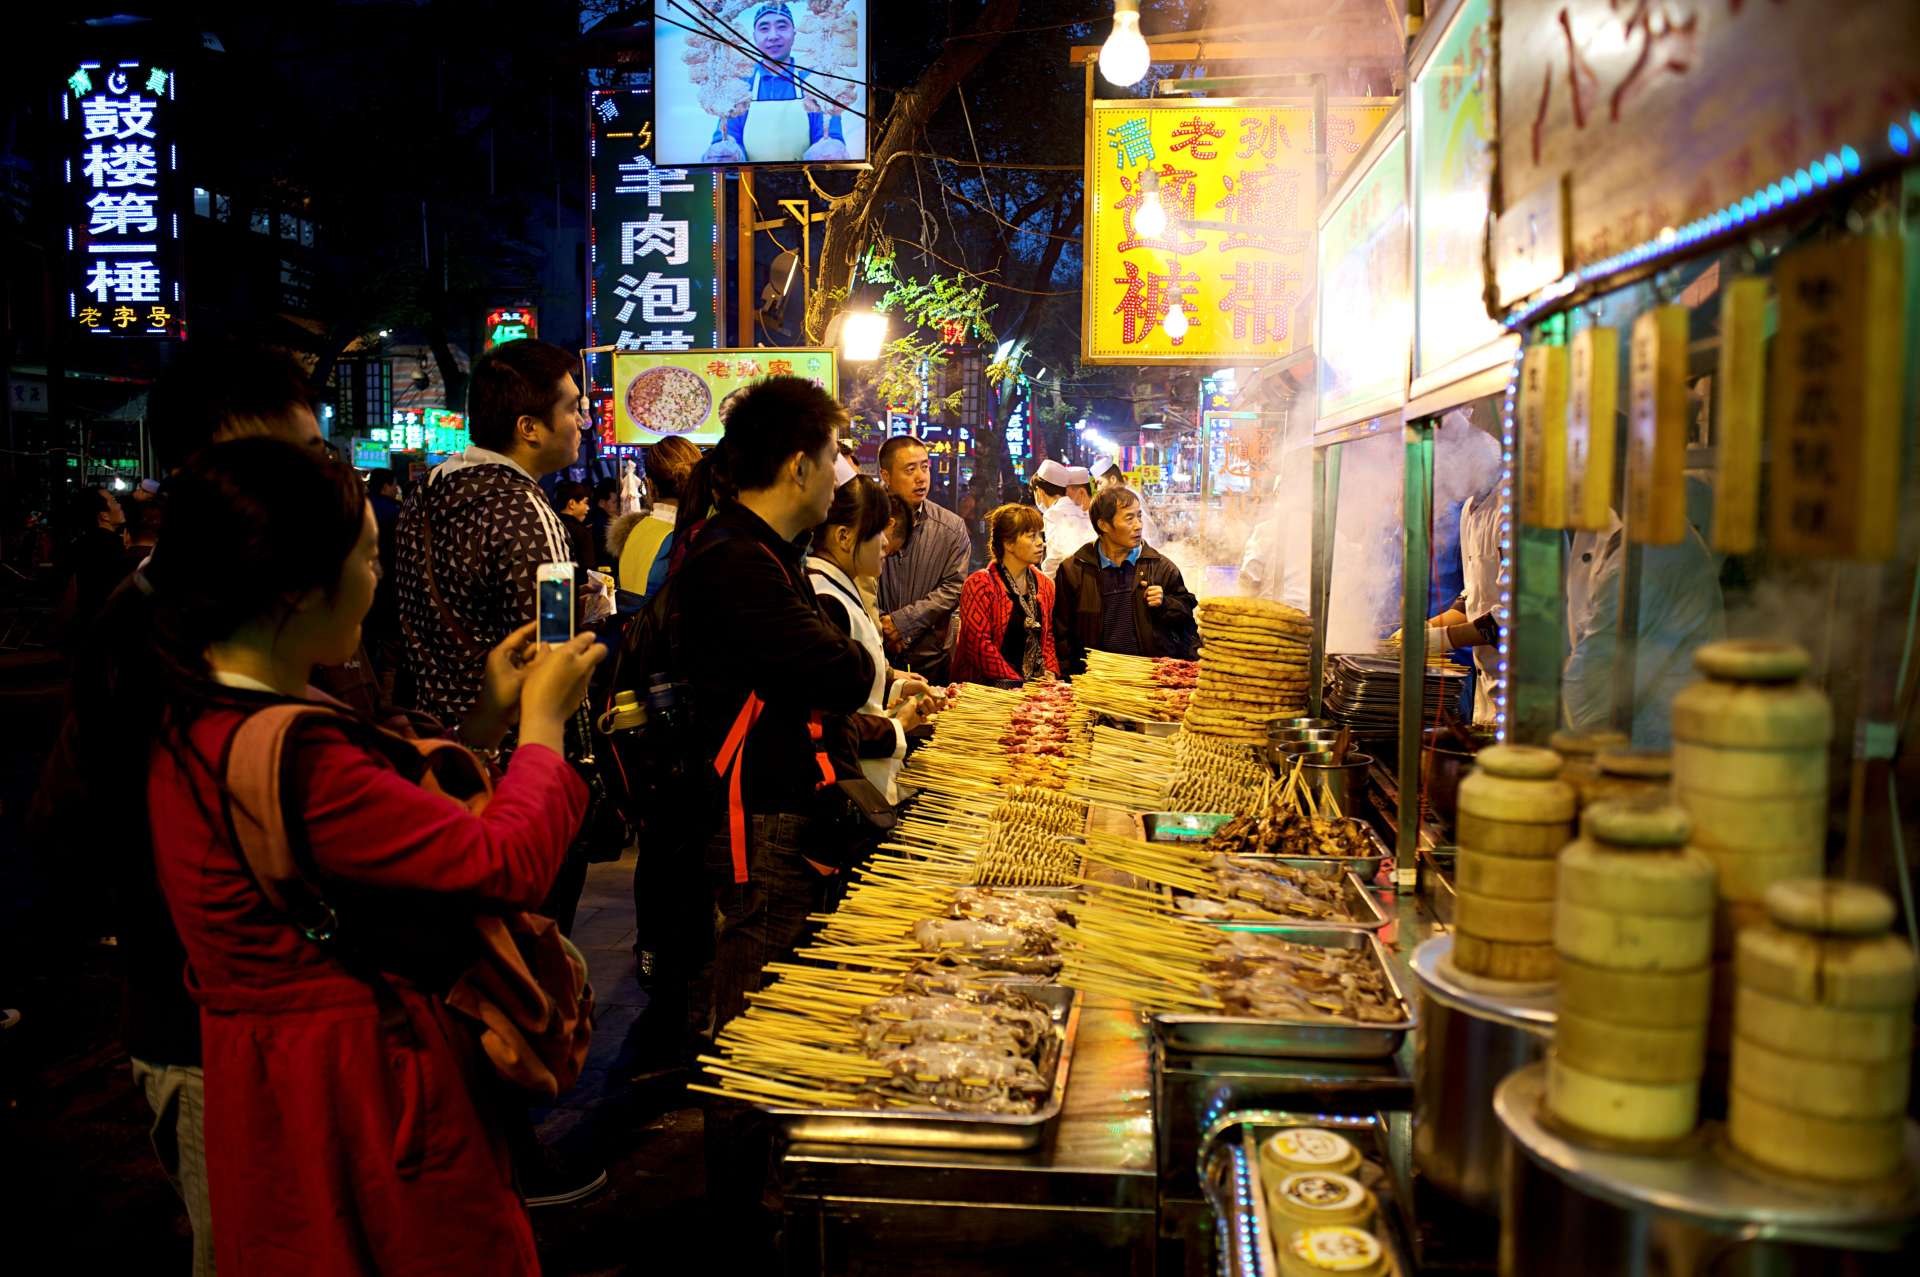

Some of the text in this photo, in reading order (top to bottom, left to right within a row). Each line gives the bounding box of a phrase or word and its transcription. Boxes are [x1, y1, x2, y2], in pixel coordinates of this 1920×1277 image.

[1107, 117, 1156, 170] 清
[79, 305, 171, 328] 老字号
[706, 358, 793, 379] 老孙家
